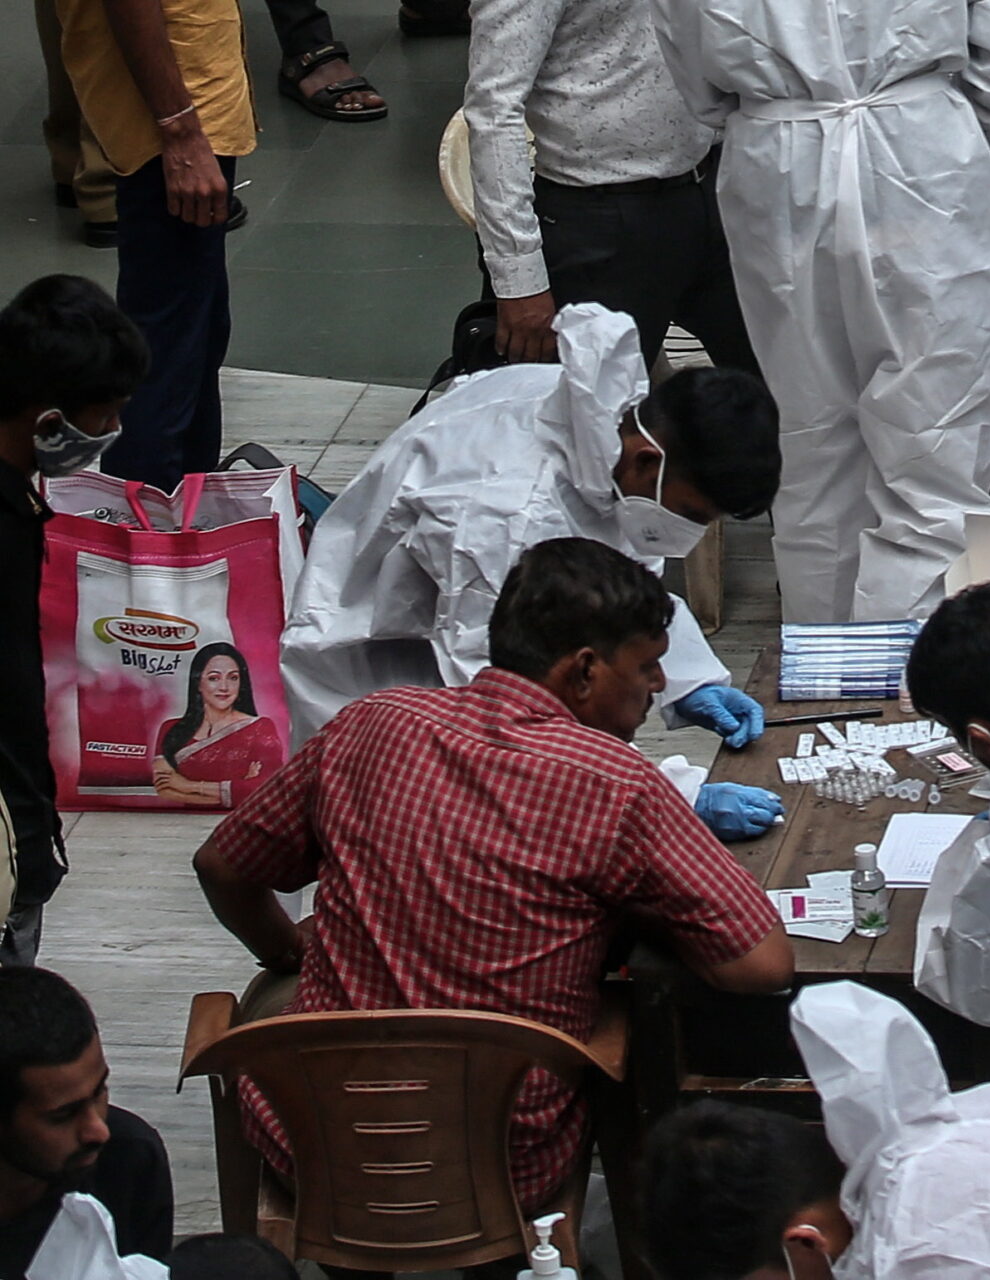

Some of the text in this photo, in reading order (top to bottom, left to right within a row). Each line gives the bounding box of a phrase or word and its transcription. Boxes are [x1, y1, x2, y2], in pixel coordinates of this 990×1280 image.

[117, 621, 183, 639] सरगम
[121, 649, 182, 674] Big Shot
